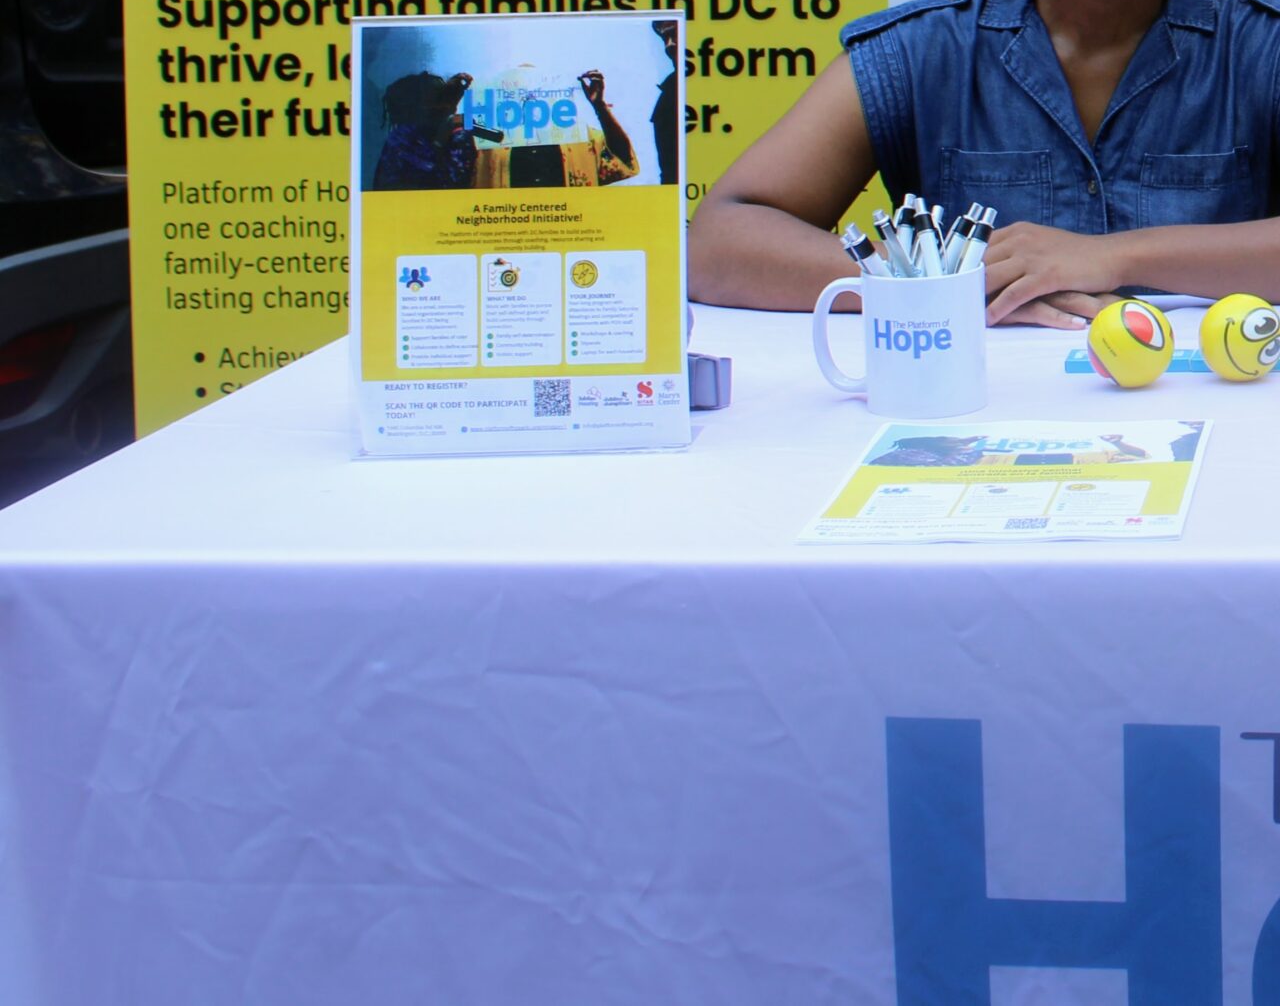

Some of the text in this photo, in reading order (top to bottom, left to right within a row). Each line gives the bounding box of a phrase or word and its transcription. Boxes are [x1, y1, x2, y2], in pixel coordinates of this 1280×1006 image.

[158, 44, 315, 88] thrive,
[159, 98, 350, 138] their fut
[463, 88, 577, 139] Hope
[163, 179, 350, 205] Platform of Ho
[456, 213, 583, 226] Neighborhood Initiative!
[473, 202, 567, 215] A Family Centered
[164, 215, 345, 244] one coaching,
[165, 250, 349, 278] family-centere
[167, 286, 254, 314] lasting
[892, 318, 950, 329] The Platform of
[874, 318, 952, 359] Hope
[218, 346, 313, 369] Achiev
[384, 383, 410, 391] READY
[427, 382, 469, 390] REGISTER?
[385, 402, 407, 410] SCAN
[426, 402, 438, 411] QR
[464, 400, 475, 408] TO
[477, 399, 528, 408] PARTICIPATE
[385, 412, 416, 420] TODAY!
[971, 437, 1093, 453] Hope
